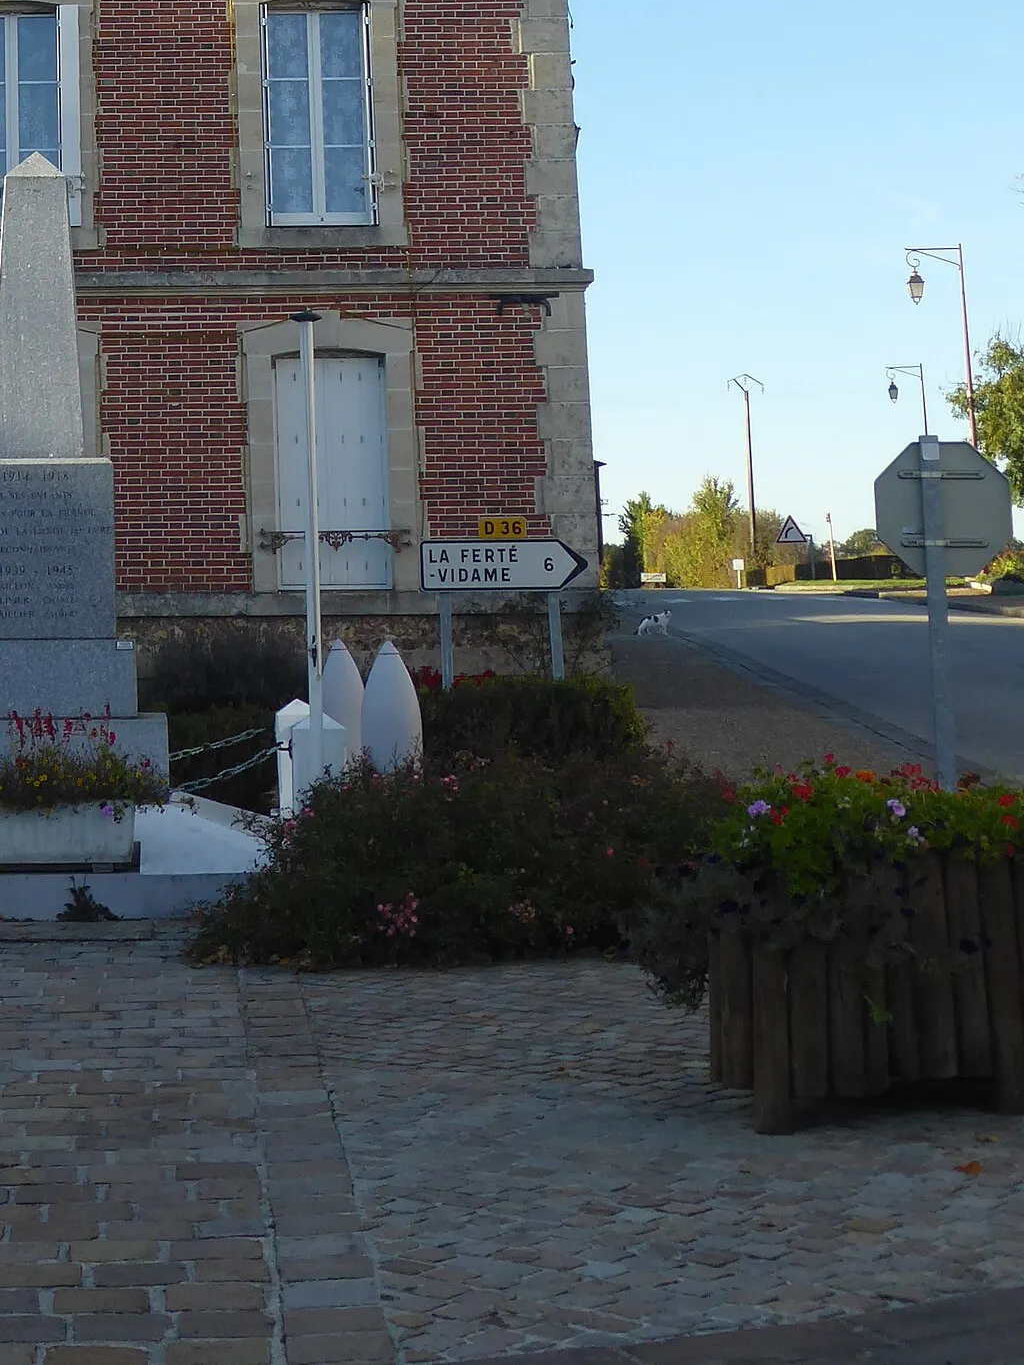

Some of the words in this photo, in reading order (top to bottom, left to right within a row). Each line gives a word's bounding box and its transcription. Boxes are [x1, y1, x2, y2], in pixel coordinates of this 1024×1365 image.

[42, 470, 70, 482] 1918
[11, 509, 36, 518] POUR
[41, 508, 53, 518] LA
[484, 521, 495, 535] D
[500, 520, 523, 535] 36
[428, 549, 451, 564] LA
[461, 545, 519, 563] FERTÉ
[46, 565, 75, 576] 1945
[544, 558, 555, 572] 6
[429, 568, 512, 583] -VIDAME
